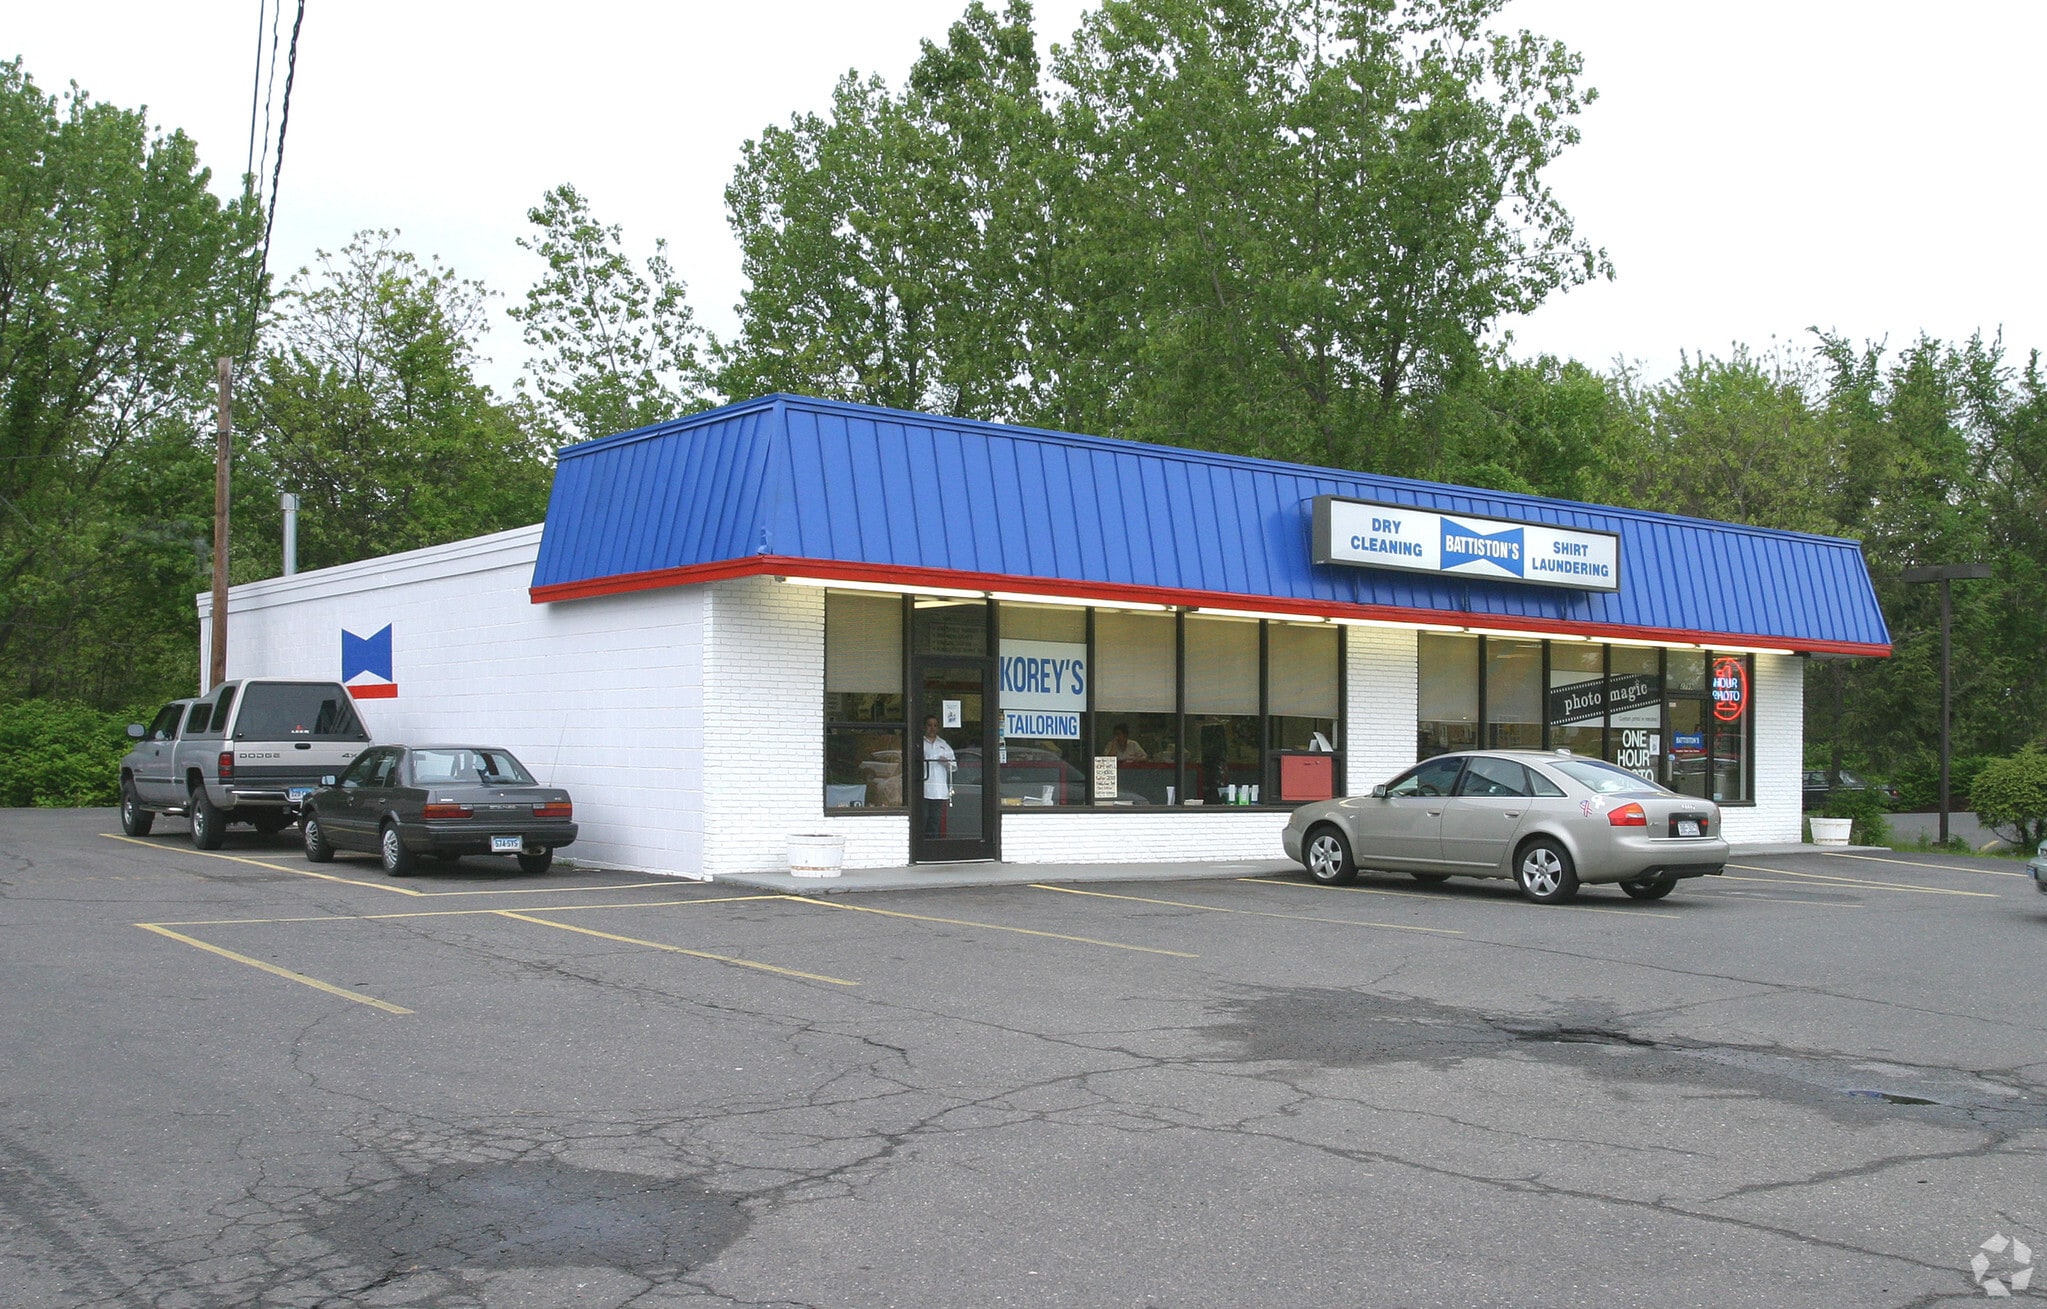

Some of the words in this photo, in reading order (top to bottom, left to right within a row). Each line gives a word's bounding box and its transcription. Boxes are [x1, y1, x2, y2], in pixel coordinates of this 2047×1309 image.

[1371, 517, 1402, 534] DRY
[1350, 535, 1423, 557] CLEANING
[1445, 534, 1520, 560] BATTISTON'S
[1553, 541, 1589, 557] SHIRT
[1531, 557, 1609, 577] LAUNDERING
[1000, 656, 1084, 695] KOREY'S
[1712, 677, 1738, 689] HOUR
[1564, 692, 1602, 716] photo
[1610, 680, 1648, 702] magic
[1007, 714, 1077, 736] TAILORING
[1622, 729, 1647, 748] ONE
[1617, 749, 1650, 767] HOUR
